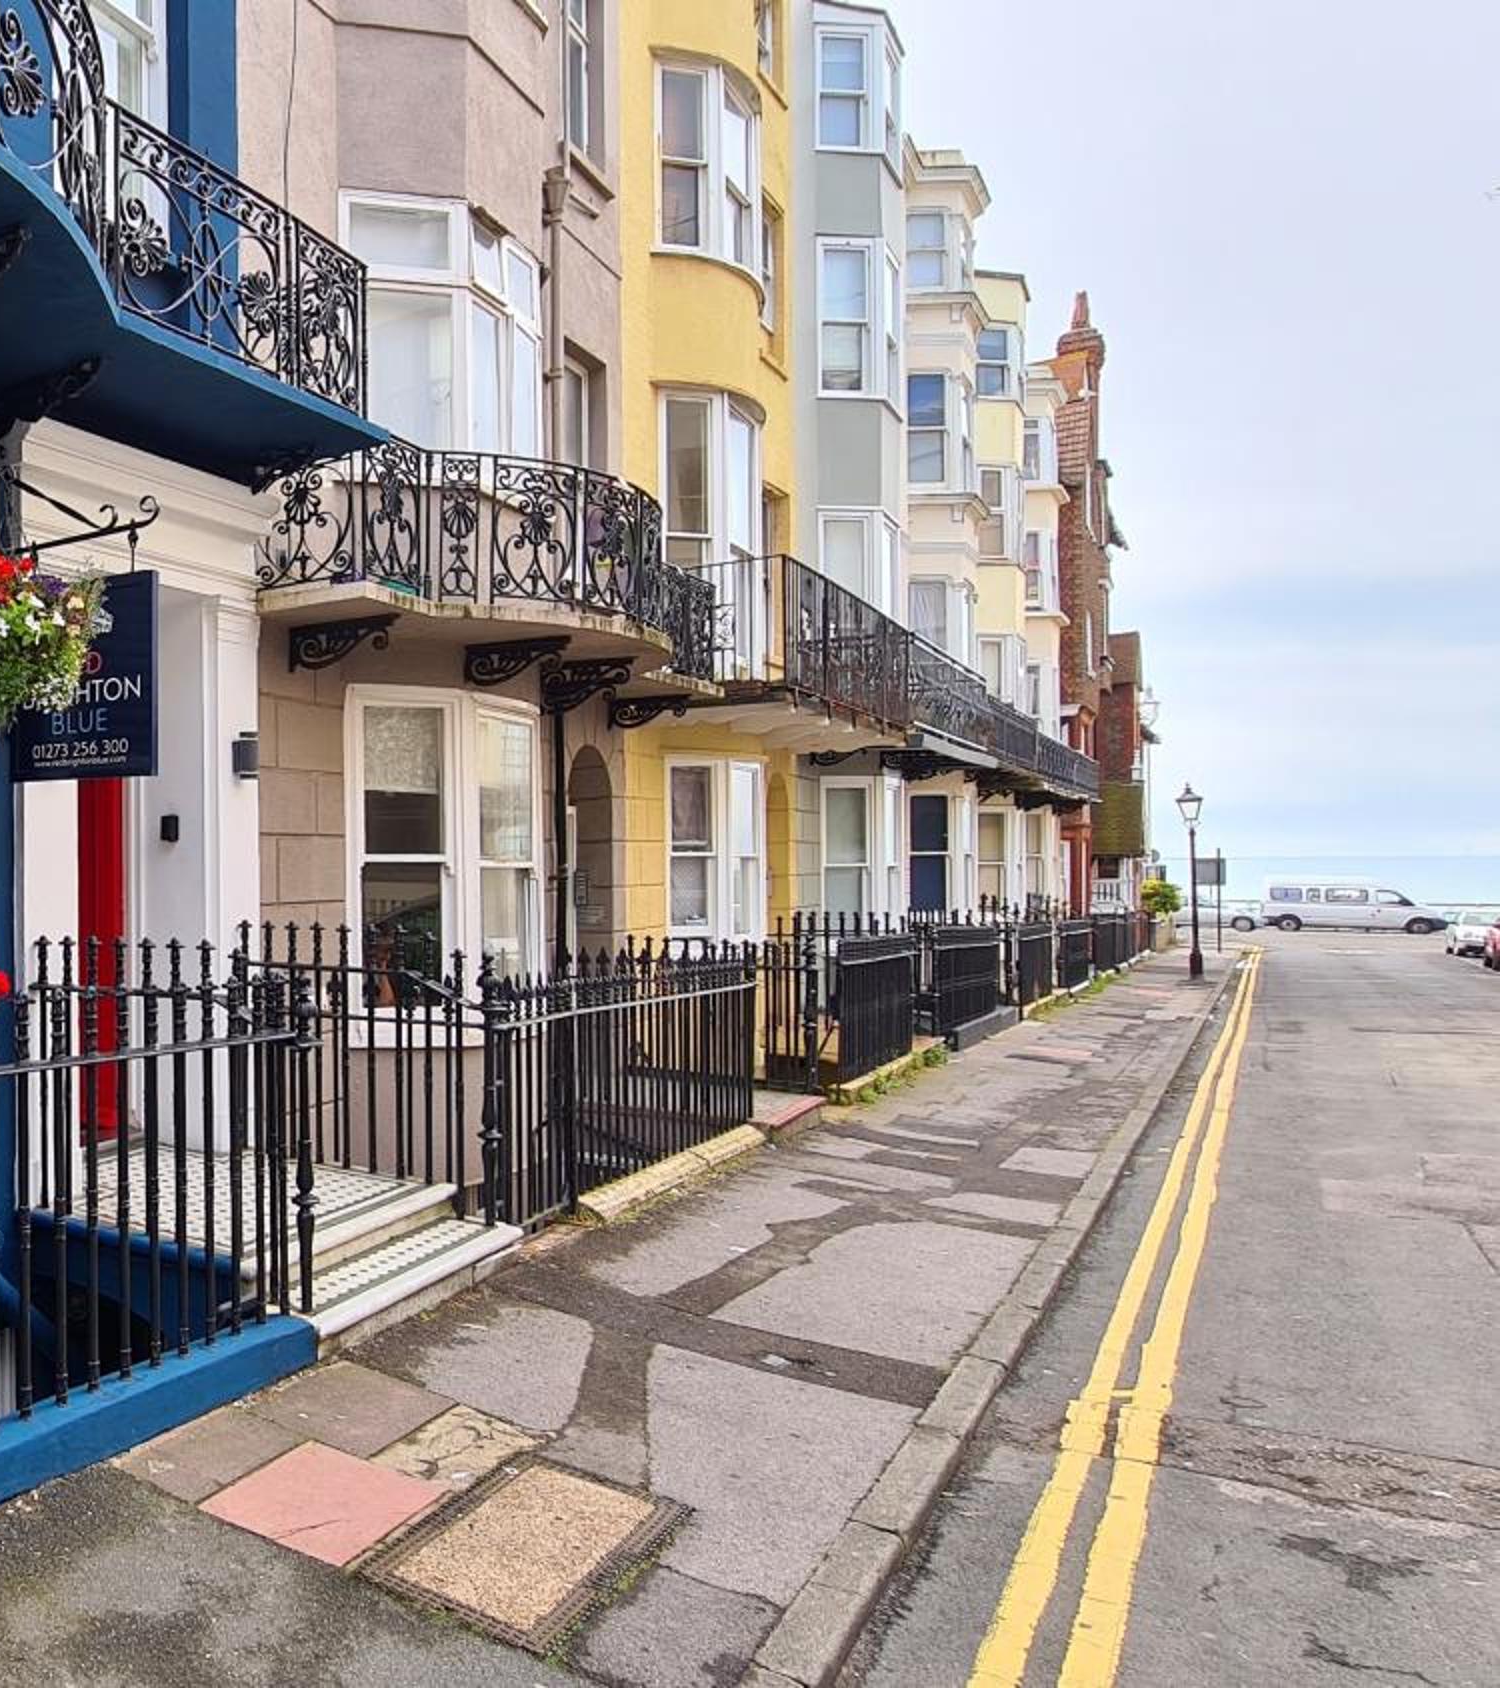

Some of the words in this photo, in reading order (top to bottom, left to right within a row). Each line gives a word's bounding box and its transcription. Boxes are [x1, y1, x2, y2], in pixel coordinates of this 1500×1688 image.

[52, 708, 108, 735] BLUE
[32, 743, 69, 759] 01273
[73, 741, 98, 757] 256
[102, 738, 129, 755] 300
